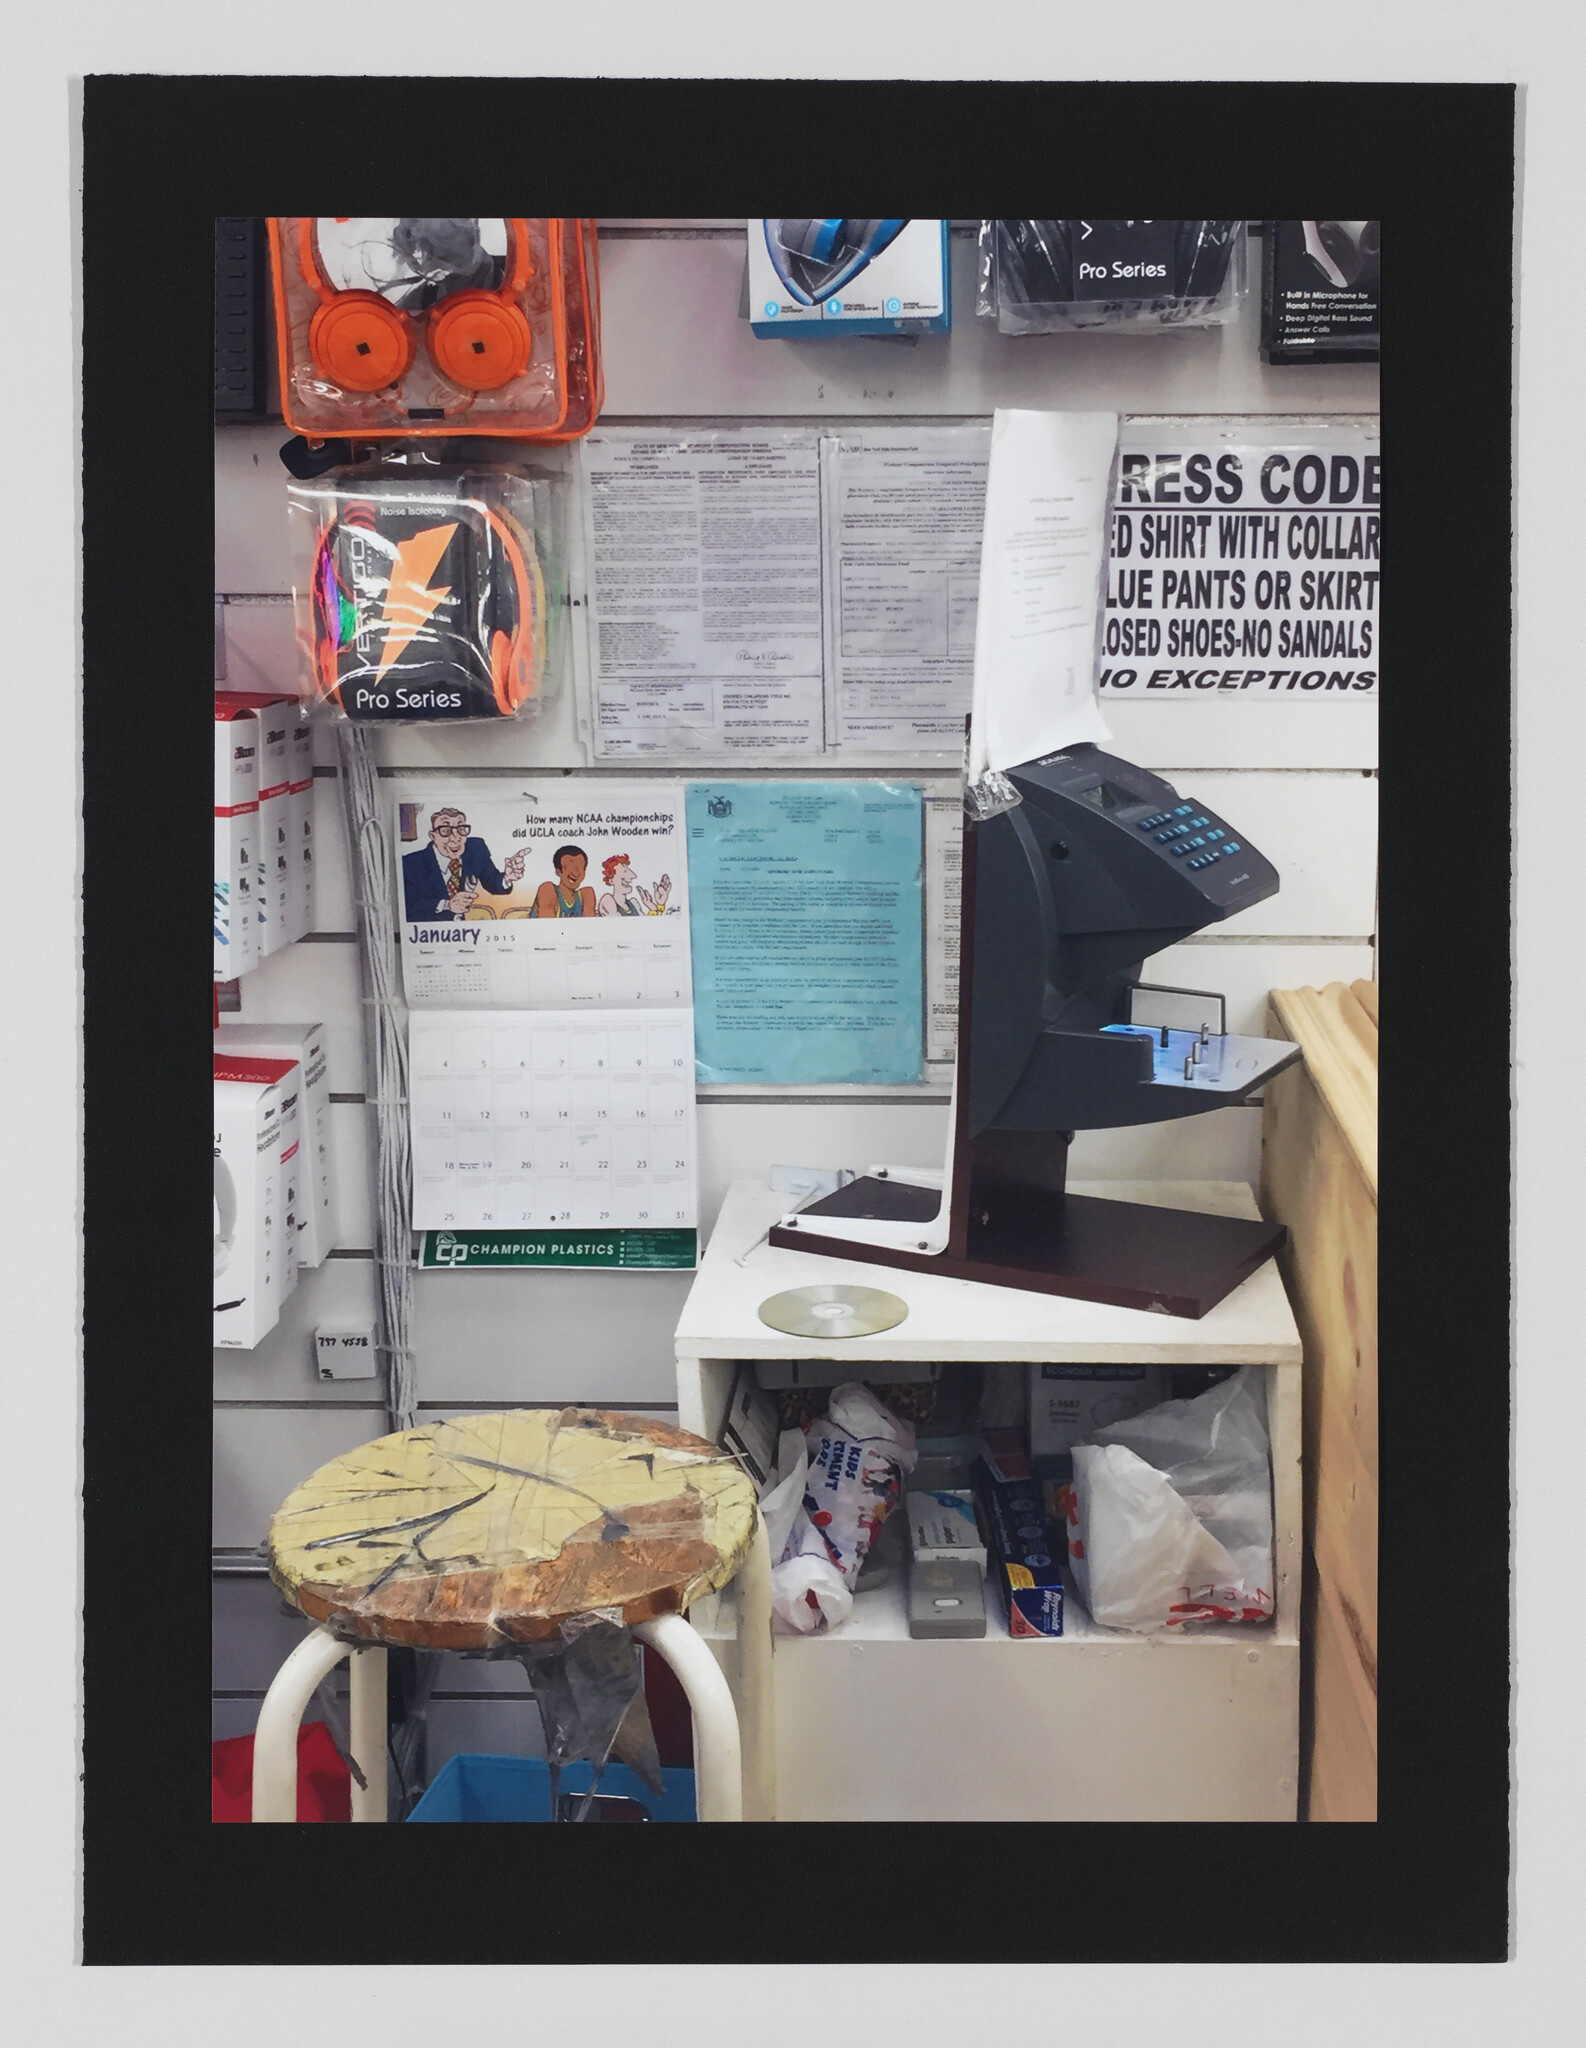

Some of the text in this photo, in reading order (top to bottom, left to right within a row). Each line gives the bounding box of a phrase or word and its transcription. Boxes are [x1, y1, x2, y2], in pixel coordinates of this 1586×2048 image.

[1079, 261, 1167, 279] Pro Series
[1304, 291, 1310, 299] in
[1312, 292, 1357, 300] Microphone
[1286, 302, 1309, 310] Hands
[1328, 302, 1377, 310] Conversation
[1285, 315, 1305, 323] Deep
[1307, 314, 1330, 323] Digital
[1260, 454, 1380, 505] CODE
[380, 506, 447, 517] Noise Isolating
[1140, 514, 1212, 559] SHIRT
[1219, 515, 1280, 559] WITH
[1287, 515, 1380, 560] COLLAR
[1162, 570, 1246, 610] PANTS
[1255, 570, 1291, 610] OR
[1299, 571, 1380, 610] SKIRT
[1102, 618, 1372, 658] OSED SHOES-NO SANDALS
[1146, 670, 1377, 690] EXCEPTIONS
[356, 689, 462, 709] Pro Series
[526, 812, 674, 827] How many NCAA championships
[512, 824, 675, 838] did UCLA coach John Wooden win?
[409, 925, 516, 945] January 2015
[636, 991, 642, 999] 2
[674, 990, 680, 999] 3
[481, 1060, 486, 1068] 5
[559, 1059, 564, 1067] 7
[597, 1059, 603, 1067] 8
[636, 1059, 641, 1067] 9
[673, 1058, 683, 1067] 10
[442, 1109, 684, 1119] 11 12 13 14 15 16 17
[482, 1161, 492, 1169] 19
[521, 1161, 531, 1169] 20
[560, 1161, 569, 1169] 21
[598, 1160, 608, 1168] 22
[636, 1160, 647, 1168] 23
[675, 1160, 685, 1168] 24
[444, 1211, 685, 1221] 25 26 27 28 29 30 31
[470, 1244, 546, 1256] CHAMPION
[551, 1244, 615, 1256] PLASTICS
[1046, 1367, 1092, 1376] ECONOMY
[845, 1446, 862, 1480] KIDS
[1040, 1590, 1053, 1613] Wrap
[1050, 1592, 1061, 1631] Reynolds
